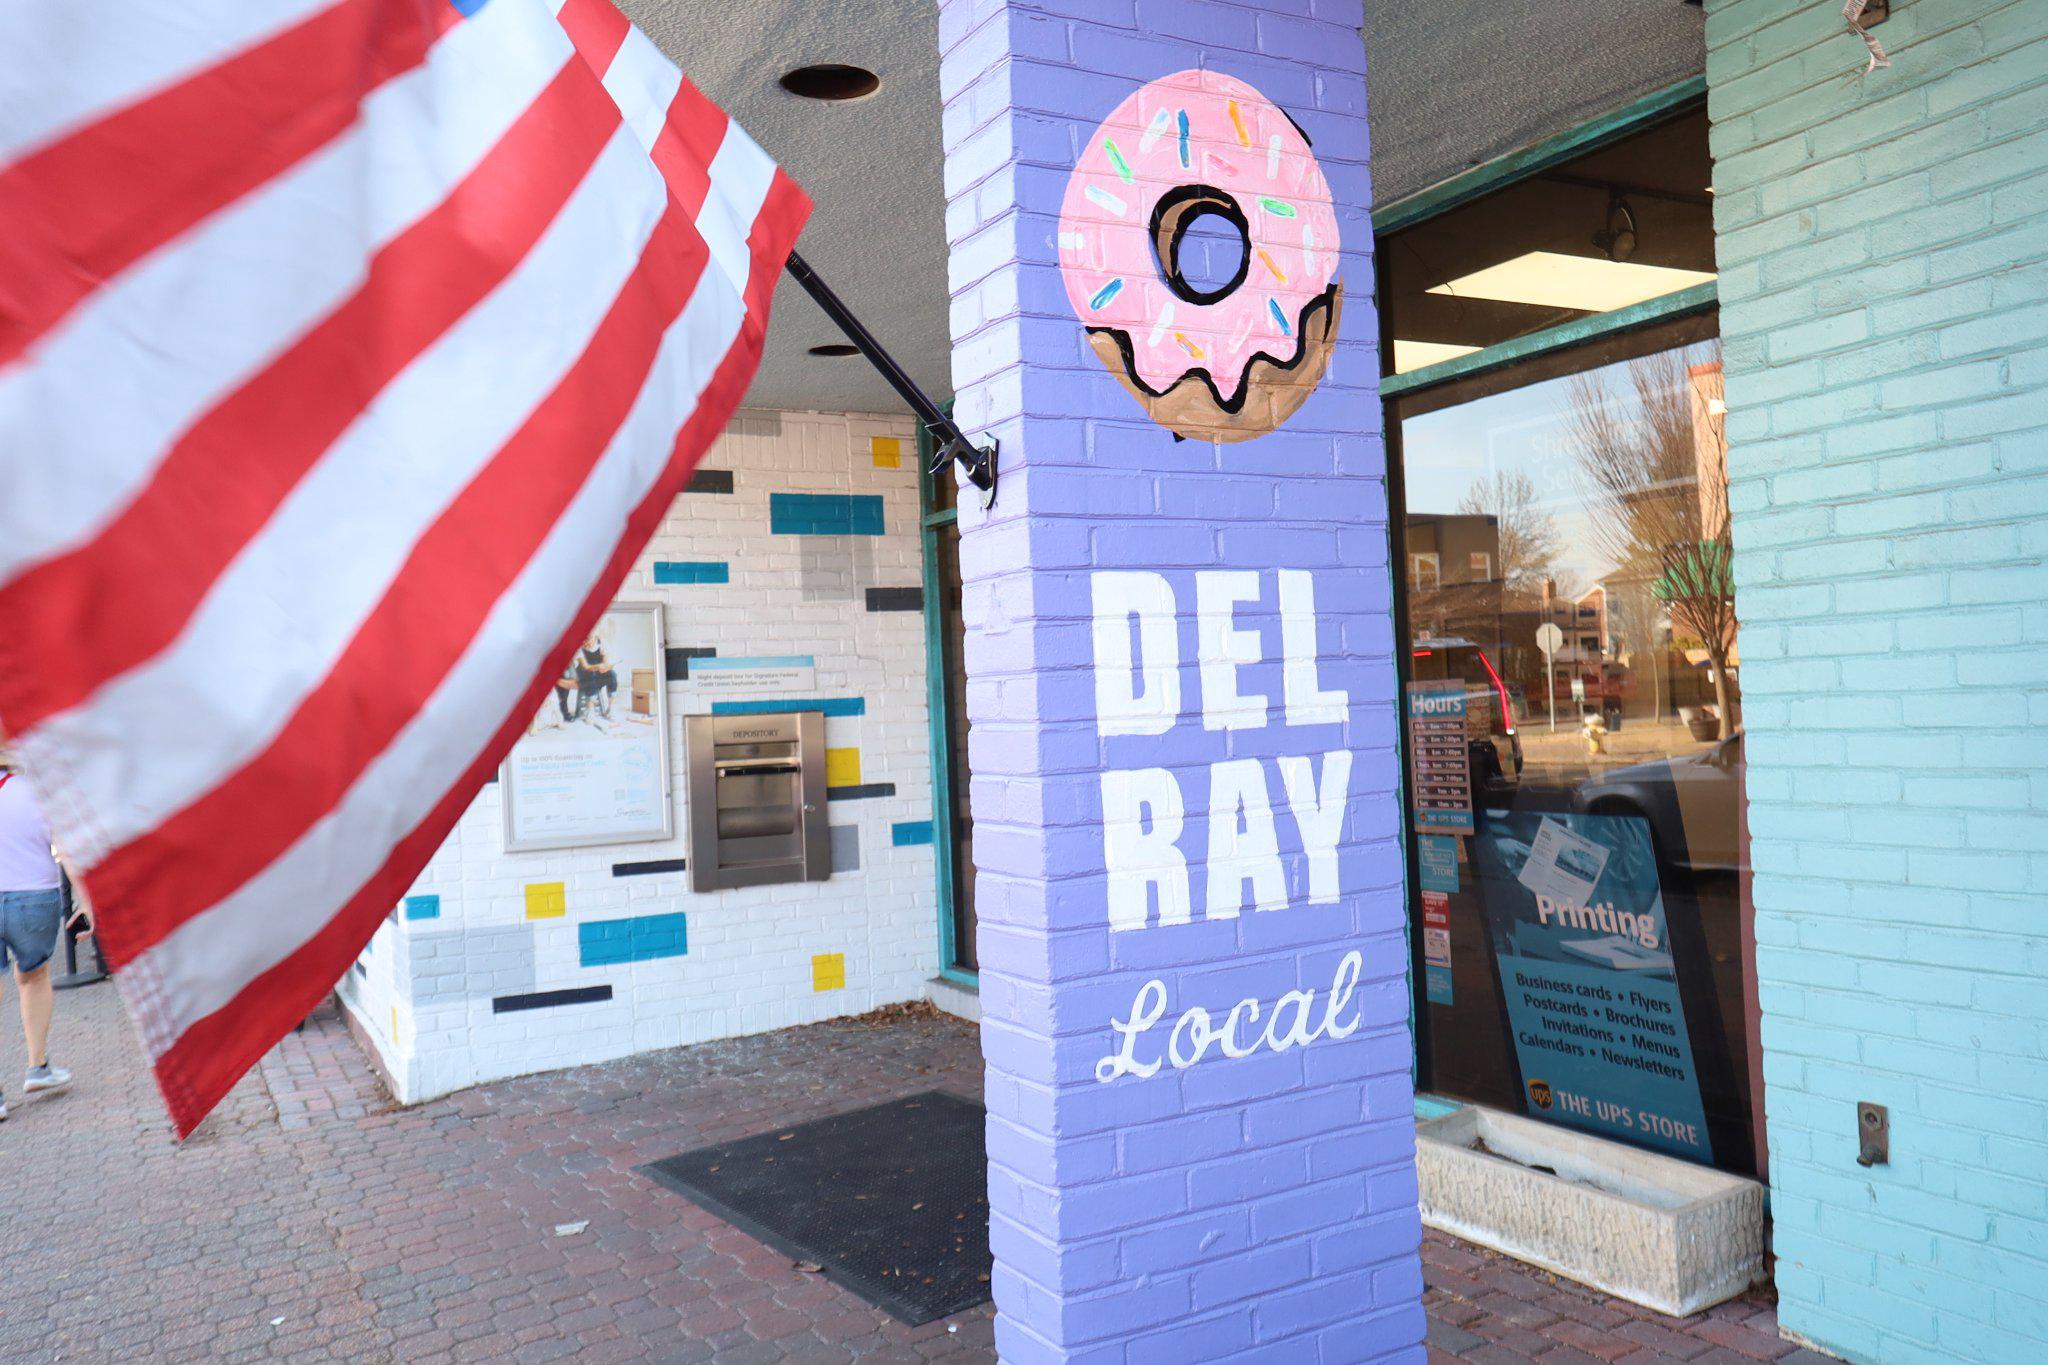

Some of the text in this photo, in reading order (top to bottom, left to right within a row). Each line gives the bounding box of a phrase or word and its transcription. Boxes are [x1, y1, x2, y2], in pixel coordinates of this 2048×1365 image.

[1090, 569, 1350, 737] DEL
[1411, 694, 1462, 714] Hours
[732, 729, 780, 740] DEPOSITORY
[1100, 749, 1354, 932] RAY
[1432, 867, 1455, 878] STORE
[1536, 894, 1660, 949] Printing
[1516, 973, 1671, 1014] Business cards Flyers
[1524, 994, 1676, 1036] Postcards Brochures
[1095, 950, 1363, 1083] Local
[1542, 1016, 1681, 1059] Invitations Menus
[1519, 1032, 1685, 1081] Calendars Newsletters
[1530, 1087, 1552, 1105] ups
[1557, 1090, 1699, 1146] THE UPS STORE
